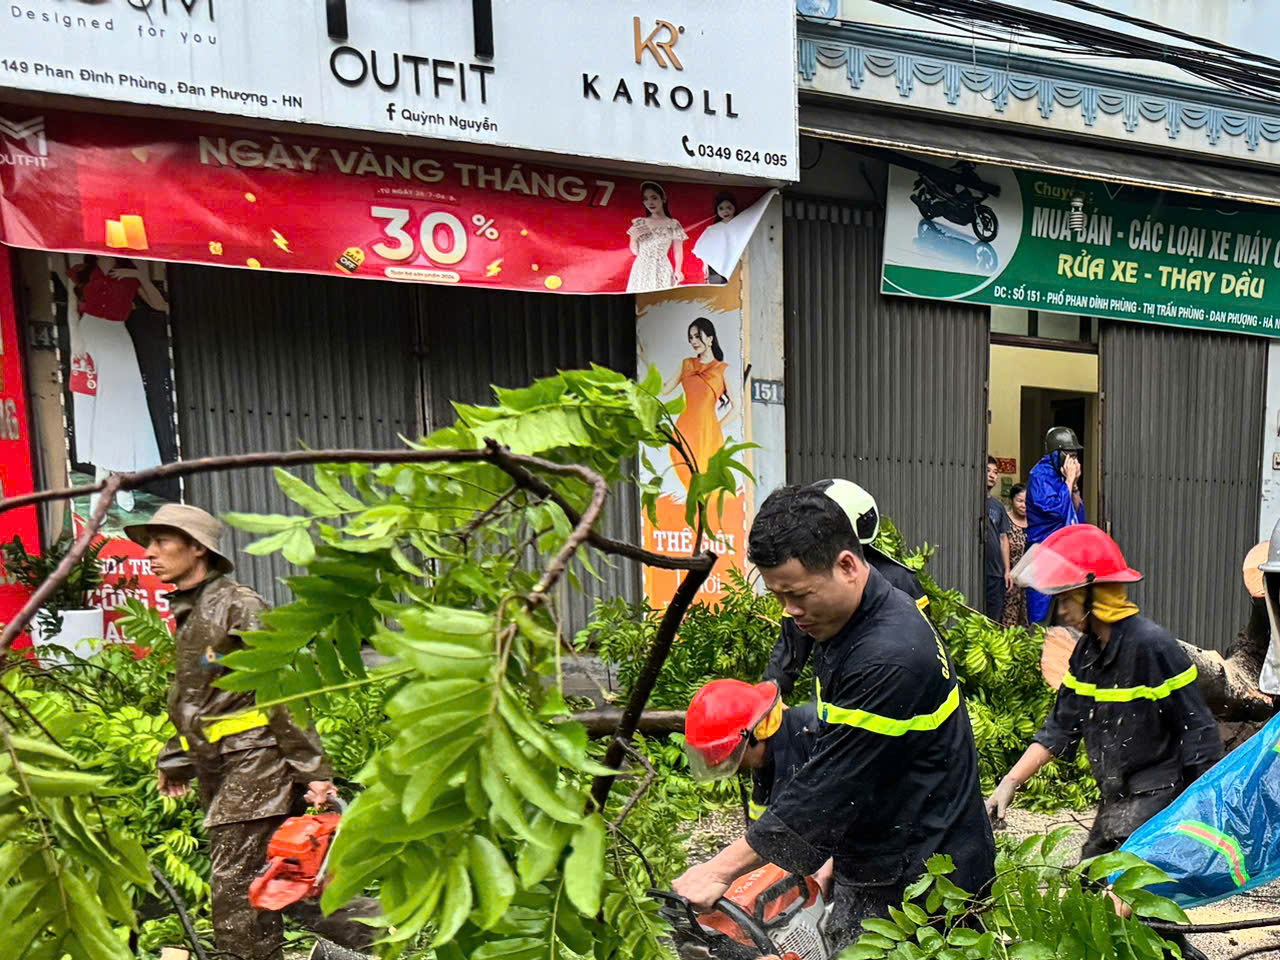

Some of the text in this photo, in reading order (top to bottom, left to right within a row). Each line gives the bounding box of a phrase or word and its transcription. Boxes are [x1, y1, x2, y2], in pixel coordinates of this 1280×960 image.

[11, 5, 114, 31] Designed
[138, 24, 166, 38] for
[180, 31, 217, 45] you
[1, 59, 29, 74] 149
[33, 63, 74, 80] Phan
[79, 69, 115, 85] Đình
[177, 81, 206, 97] Đan
[210, 86, 268, 107] Phượng
[282, 94, 303, 109] HN
[330, 46, 495, 104] OUTFIT
[582, 73, 739, 119] KAROLL
[401, 108, 445, 126] Quỳnh
[449, 115, 498, 132] Nguyễn
[198, 135, 616, 207] NGÀY VÀNG THÁNG 7
[698, 143, 788, 167] 0349 624 095
[1031, 206, 1072, 242] MUA
[1128, 214, 1164, 253] CÁC
[1167, 224, 1207, 264] LOẠI
[1208, 229, 1232, 261] XE
[1234, 230, 1272, 267] MÁY
[1057, 249, 1105, 281] RỬA
[1110, 259, 1139, 284] XE
[1158, 265, 1216, 295] THAY
[1220, 268, 1265, 299] DẦU
[1012, 283, 1027, 301] SỐ
[1027, 289, 1041, 303] 151
[1047, 288, 1065, 305] PHỐ
[1065, 294, 1088, 308] PHAN
[1110, 296, 1137, 313] PHÙNG
[1143, 302, 1156, 318] THỊ
[1157, 301, 1178, 318] TRẤN
[1178, 304, 1205, 321] PHÙNG
[1227, 312, 1258, 329] PHƯỢNG
[1263, 315, 1274, 329] HÀ
[753, 382, 778, 401] 151
